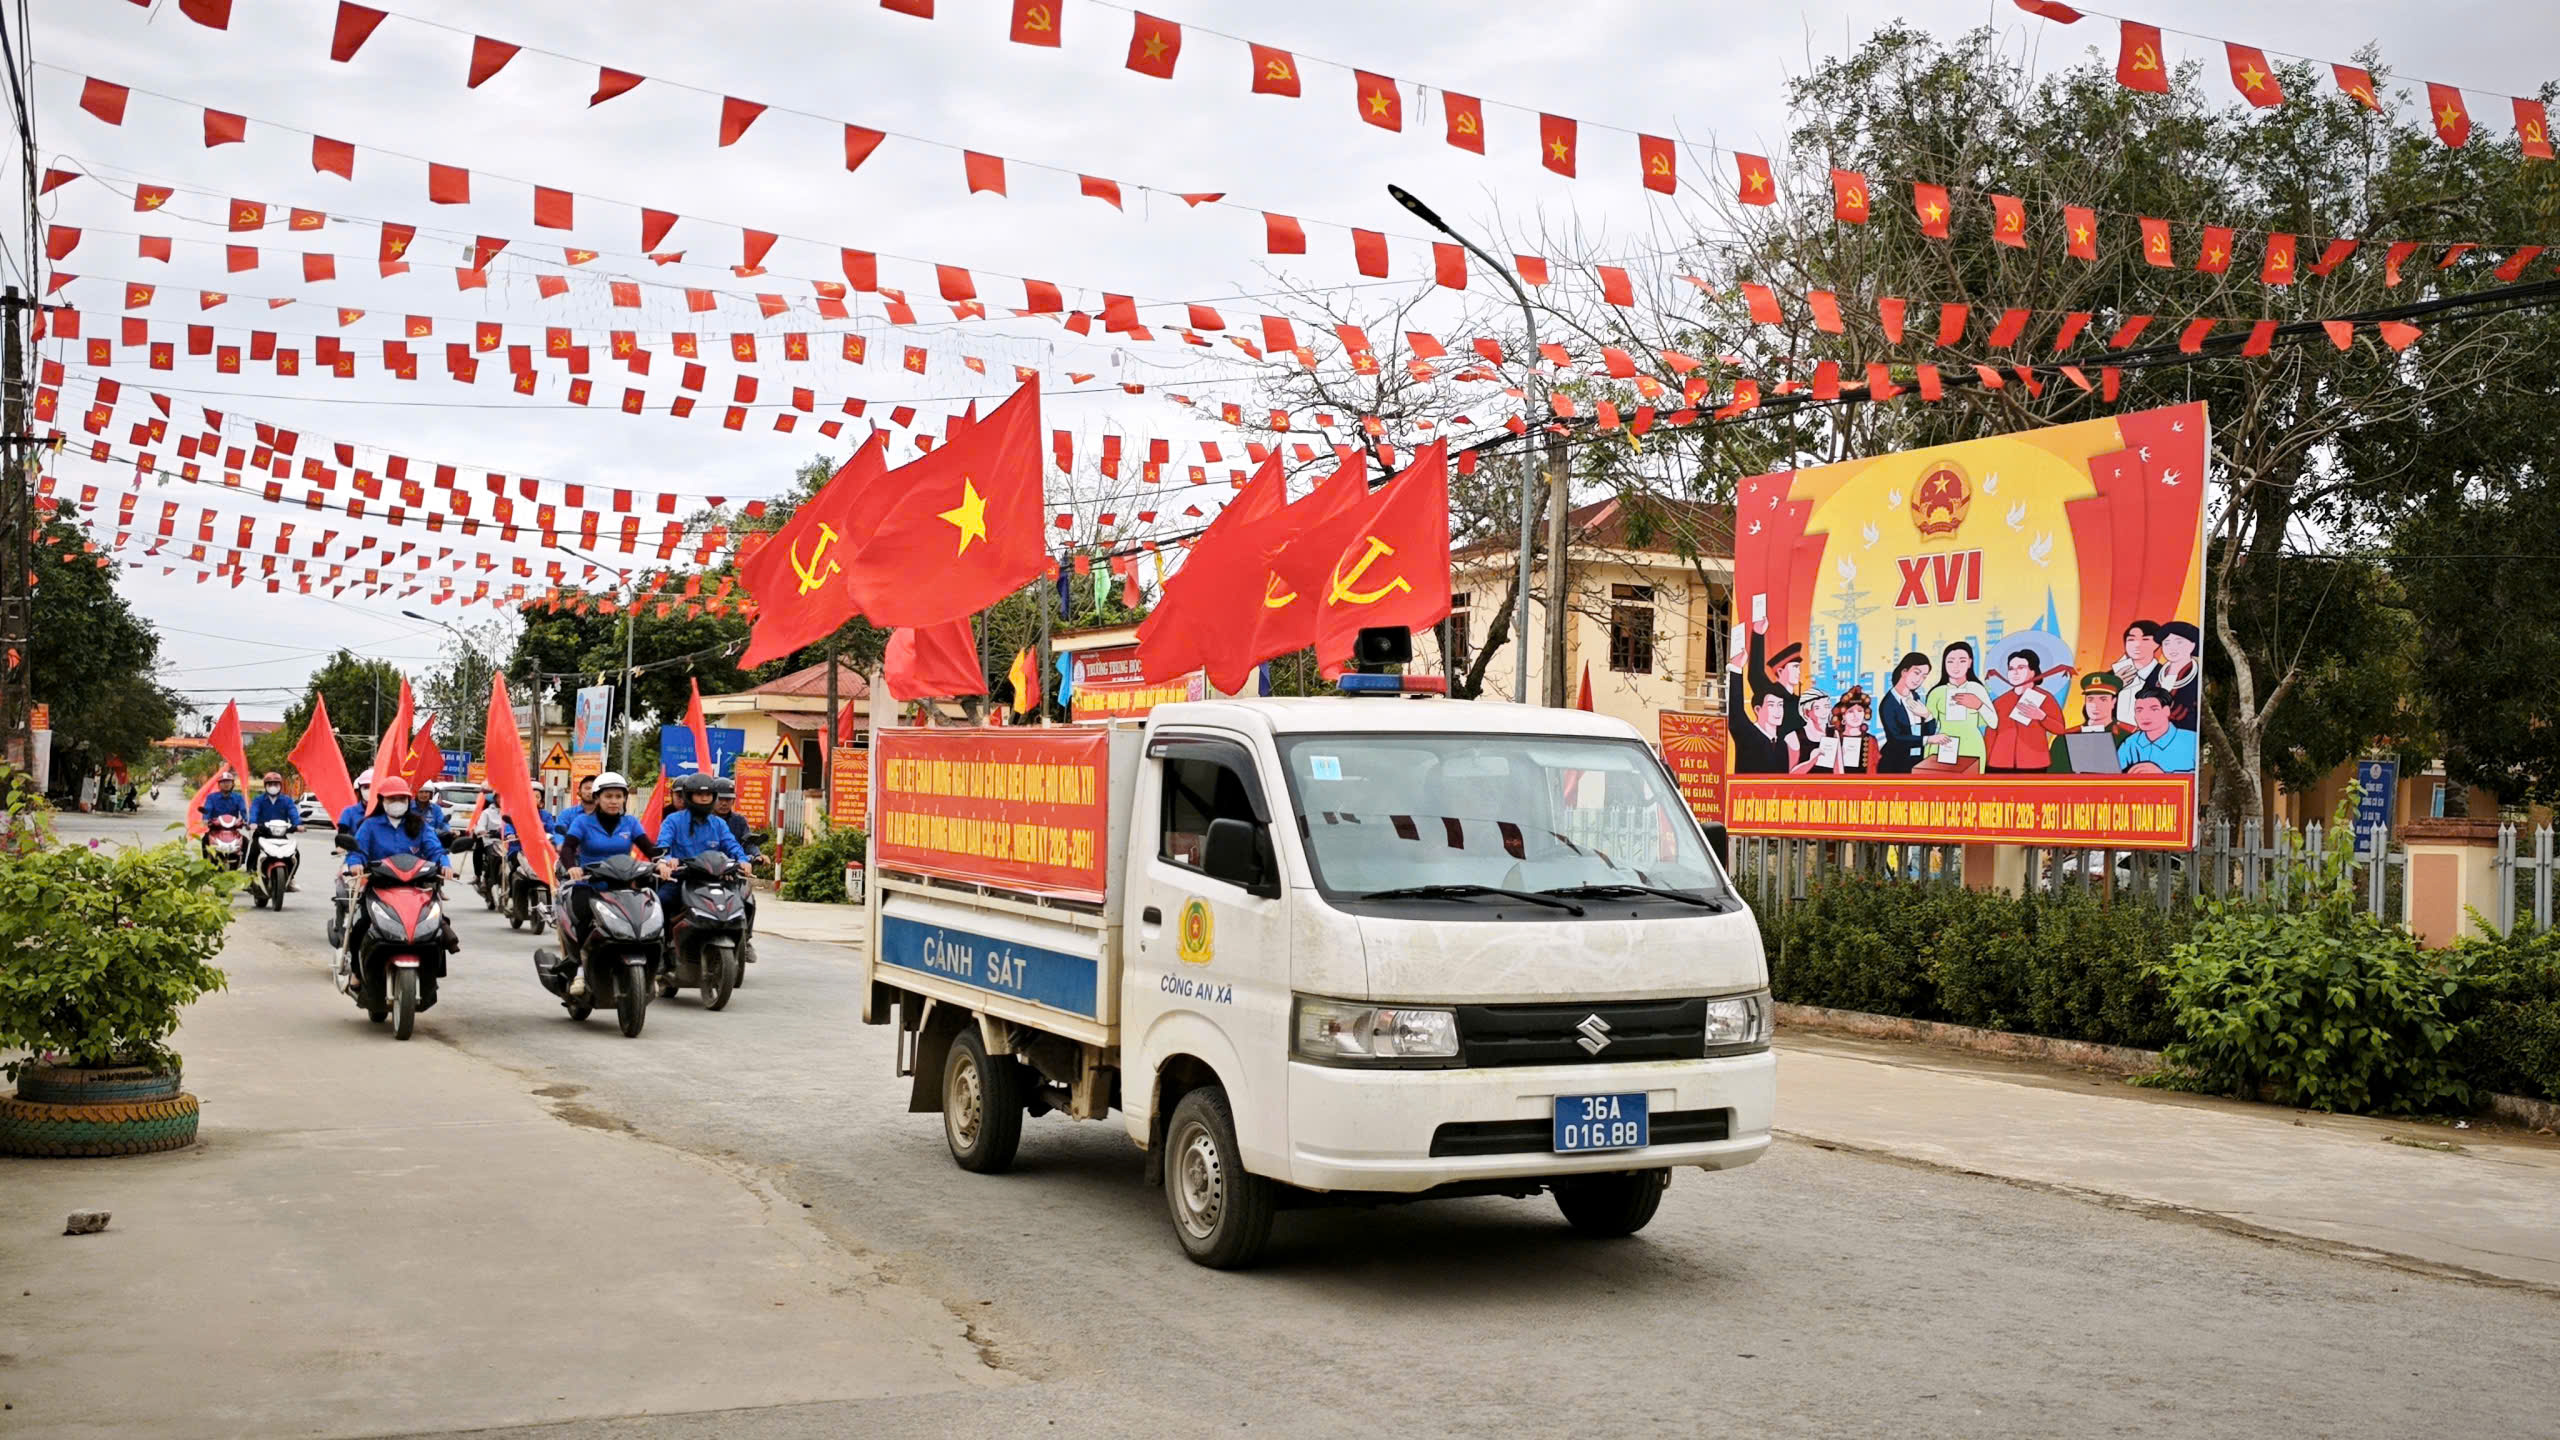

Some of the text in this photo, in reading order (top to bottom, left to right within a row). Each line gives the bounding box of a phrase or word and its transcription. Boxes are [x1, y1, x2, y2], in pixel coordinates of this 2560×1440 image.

[1893, 548, 1983, 609] XVI
[1109, 660, 1129, 675] TRUNG
[1679, 755, 1709, 769] TẤT CẢ
[1679, 772, 1699, 785] MỤC
[1701, 772, 1720, 785] TIÊU
[924, 930, 1027, 990] CẢNH SÁT
[1160, 972, 1232, 1005] CÔNG AN XÃ
[1581, 1095, 1622, 1121] 36A
[1564, 1121, 1638, 1148] 016.88
